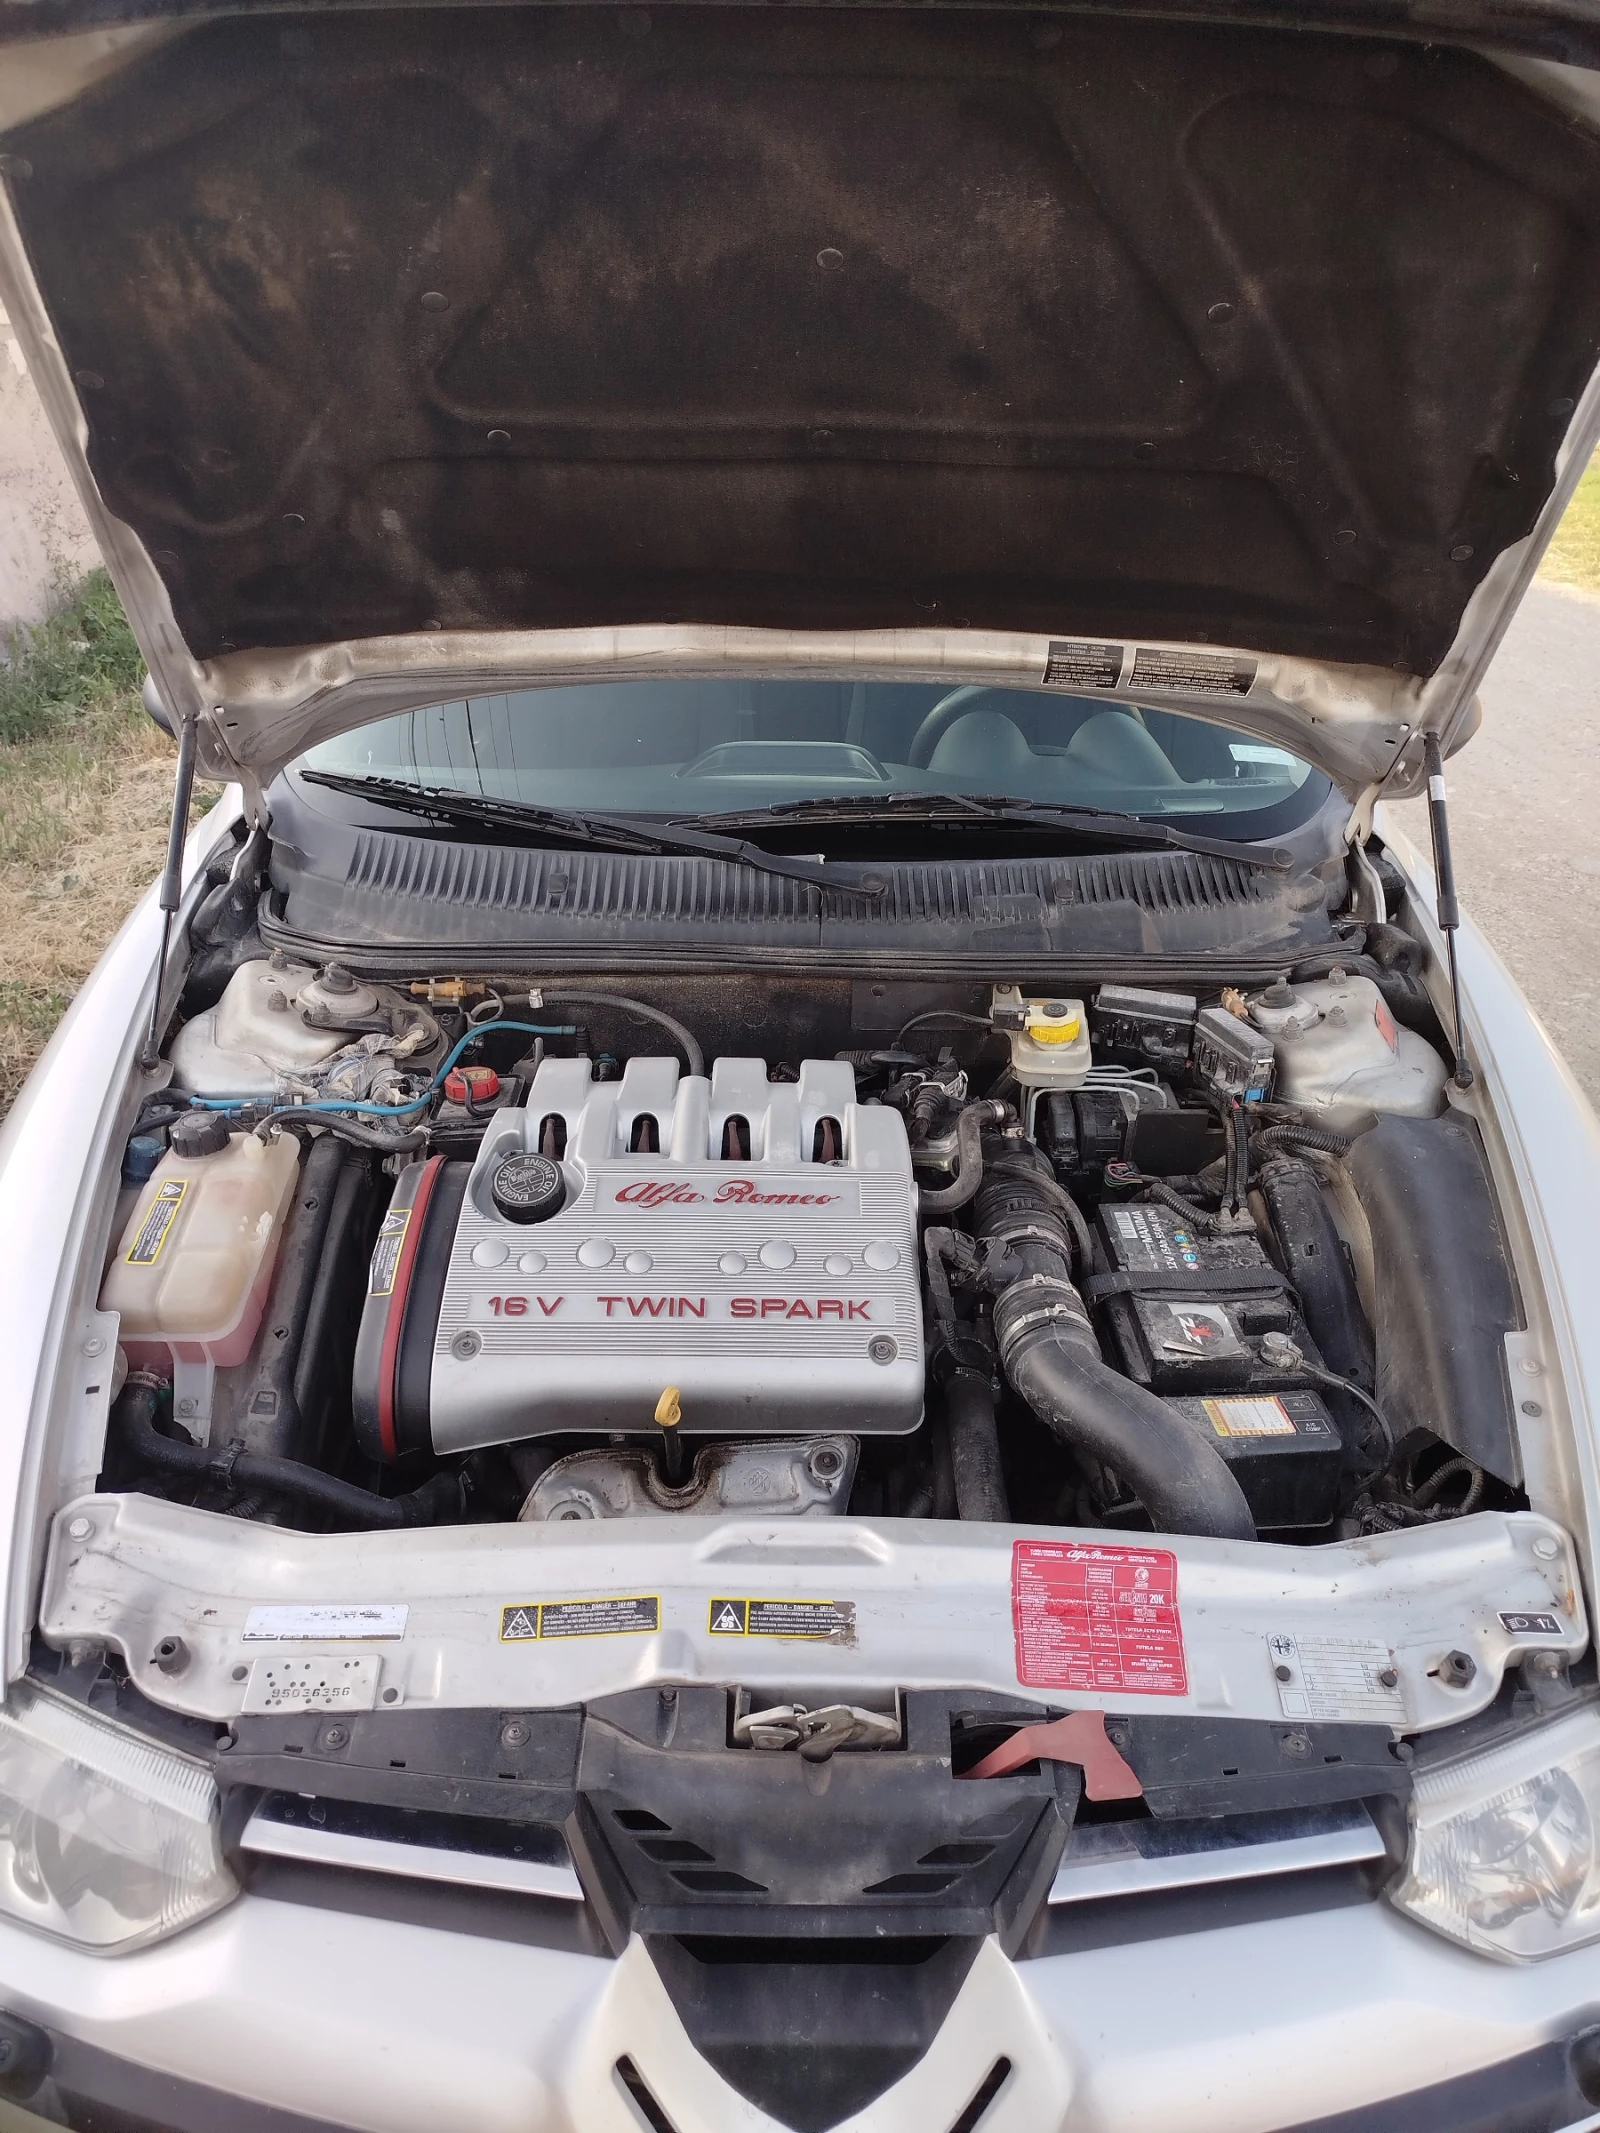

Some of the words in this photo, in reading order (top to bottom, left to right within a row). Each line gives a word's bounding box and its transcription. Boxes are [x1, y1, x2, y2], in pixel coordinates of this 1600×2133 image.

[500, 1165, 516, 1178] OIL
[524, 1158, 554, 1179] ENGINE
[498, 1180, 529, 1201] ENGINE
[537, 1181, 553, 1193] OIL
[615, 1182, 705, 1209] Alfa
[713, 1179, 842, 1205] Romeo
[1131, 1210, 1153, 1243] MAXIMA
[597, 1297, 705, 1318] TWIN
[730, 1298, 871, 1320] SPARK
[1149, 1594, 1164, 1604] 20K
[562, 1604, 585, 1613] PERICOLO
[592, 1603, 611, 1611] DANGER
[1361, 1662, 1368, 1670] kg
[271, 1687, 351, 1698] 95036356
[1310, 1682, 1318, 1690] 2-
[1367, 1686, 1374, 1694] kg
